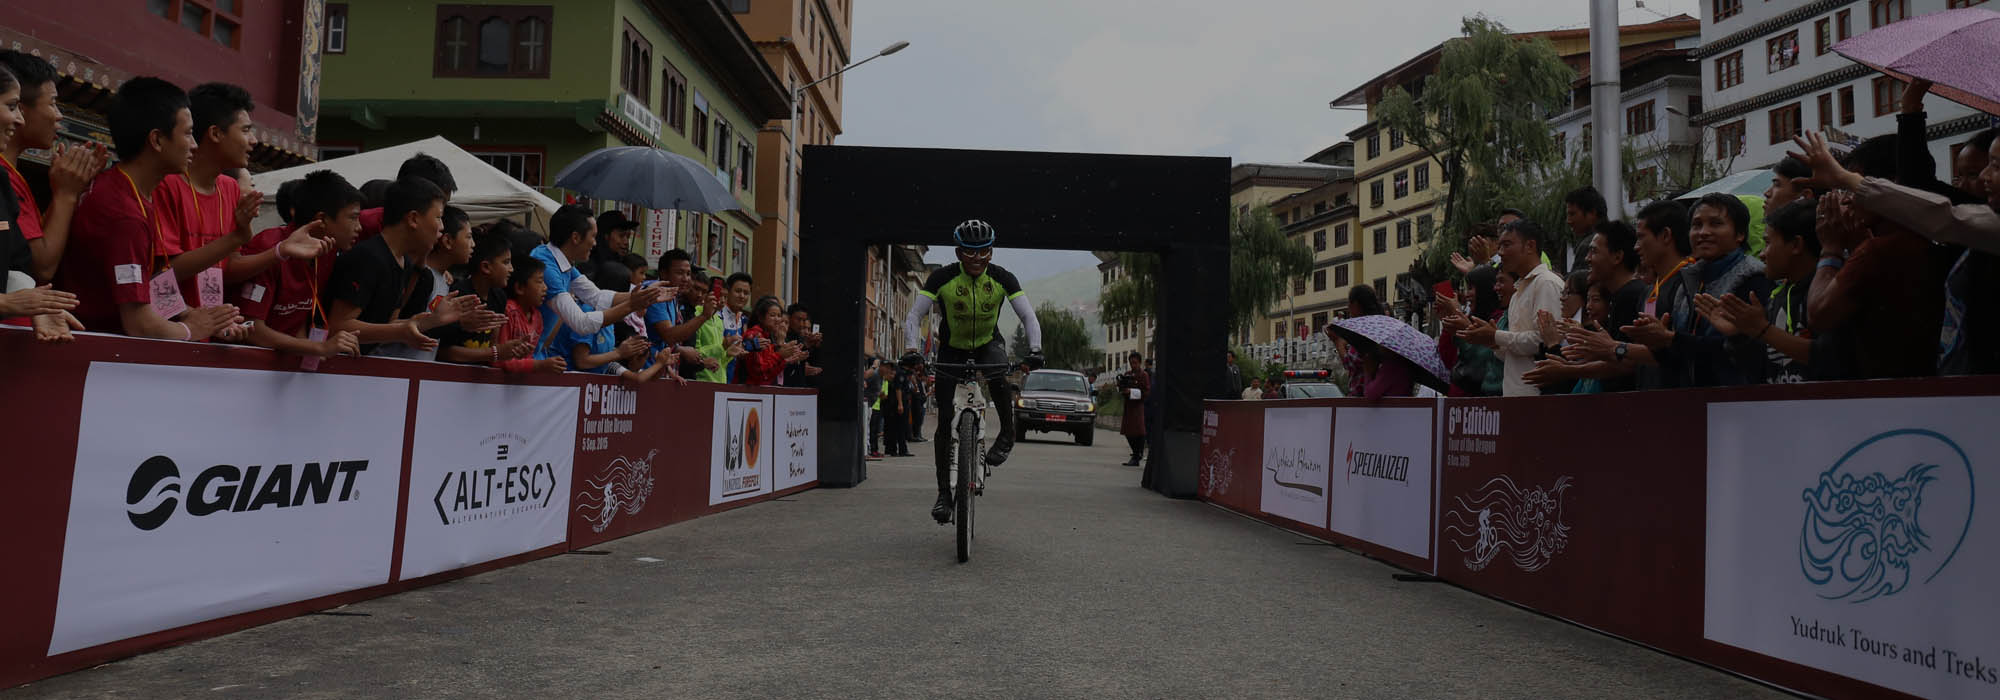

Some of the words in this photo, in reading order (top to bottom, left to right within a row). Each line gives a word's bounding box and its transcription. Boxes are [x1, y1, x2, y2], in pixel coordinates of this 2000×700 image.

[584, 383, 600, 415] 6th
[600, 384, 637, 415] Edition
[967, 392, 975, 404] 2
[1449, 406, 1462, 435] 6th
[1463, 406, 1500, 436] Edition
[1352, 451, 1410, 483] SPECIALIZED
[186, 460, 369, 516] GIANT
[1791, 615, 1847, 648] Yudruk
[1850, 628, 1898, 660] Tours
[1902, 646, 1937, 670] and
[1942, 649, 1999, 685] Treks
